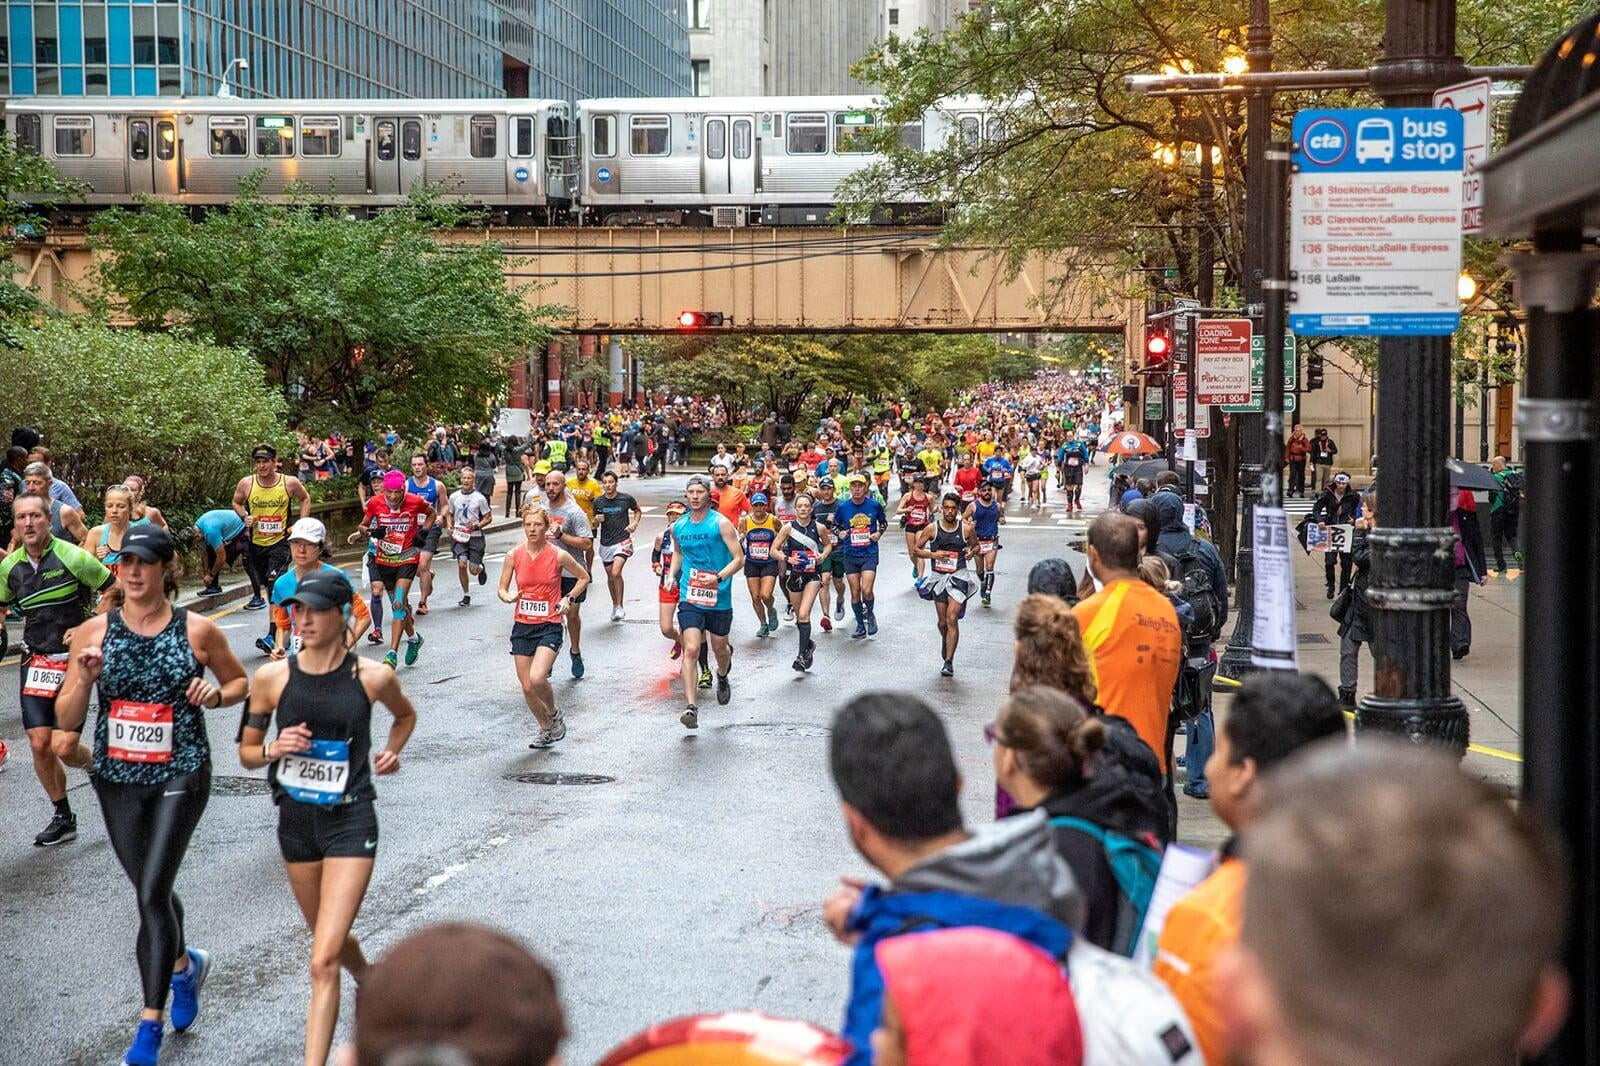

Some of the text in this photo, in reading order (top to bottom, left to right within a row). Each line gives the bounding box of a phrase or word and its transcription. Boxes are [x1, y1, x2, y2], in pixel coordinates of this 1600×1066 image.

[1402, 116, 1447, 138] bus
[1310, 133, 1342, 149] cta
[1401, 140, 1456, 165] stop
[1302, 185, 1323, 196] 134
[1411, 185, 1449, 196] Express
[1302, 215, 1323, 225] 135
[1417, 215, 1456, 225] Express
[1462, 207, 1483, 228] ONE
[1301, 243, 1448, 254] 136 Sheridan/LaSalle Express
[1301, 274, 1361, 284] 156 LaSalle
[1211, 394, 1227, 403] 801
[1229, 394, 1244, 403] 904
[680, 533, 710, 541] PATRICK
[696, 589, 713, 598] 8740
[520, 600, 546, 611] E 17615
[33, 670, 61, 685] D 8635
[116, 723, 163, 743] D 7829
[282, 757, 344, 783] F 25617
